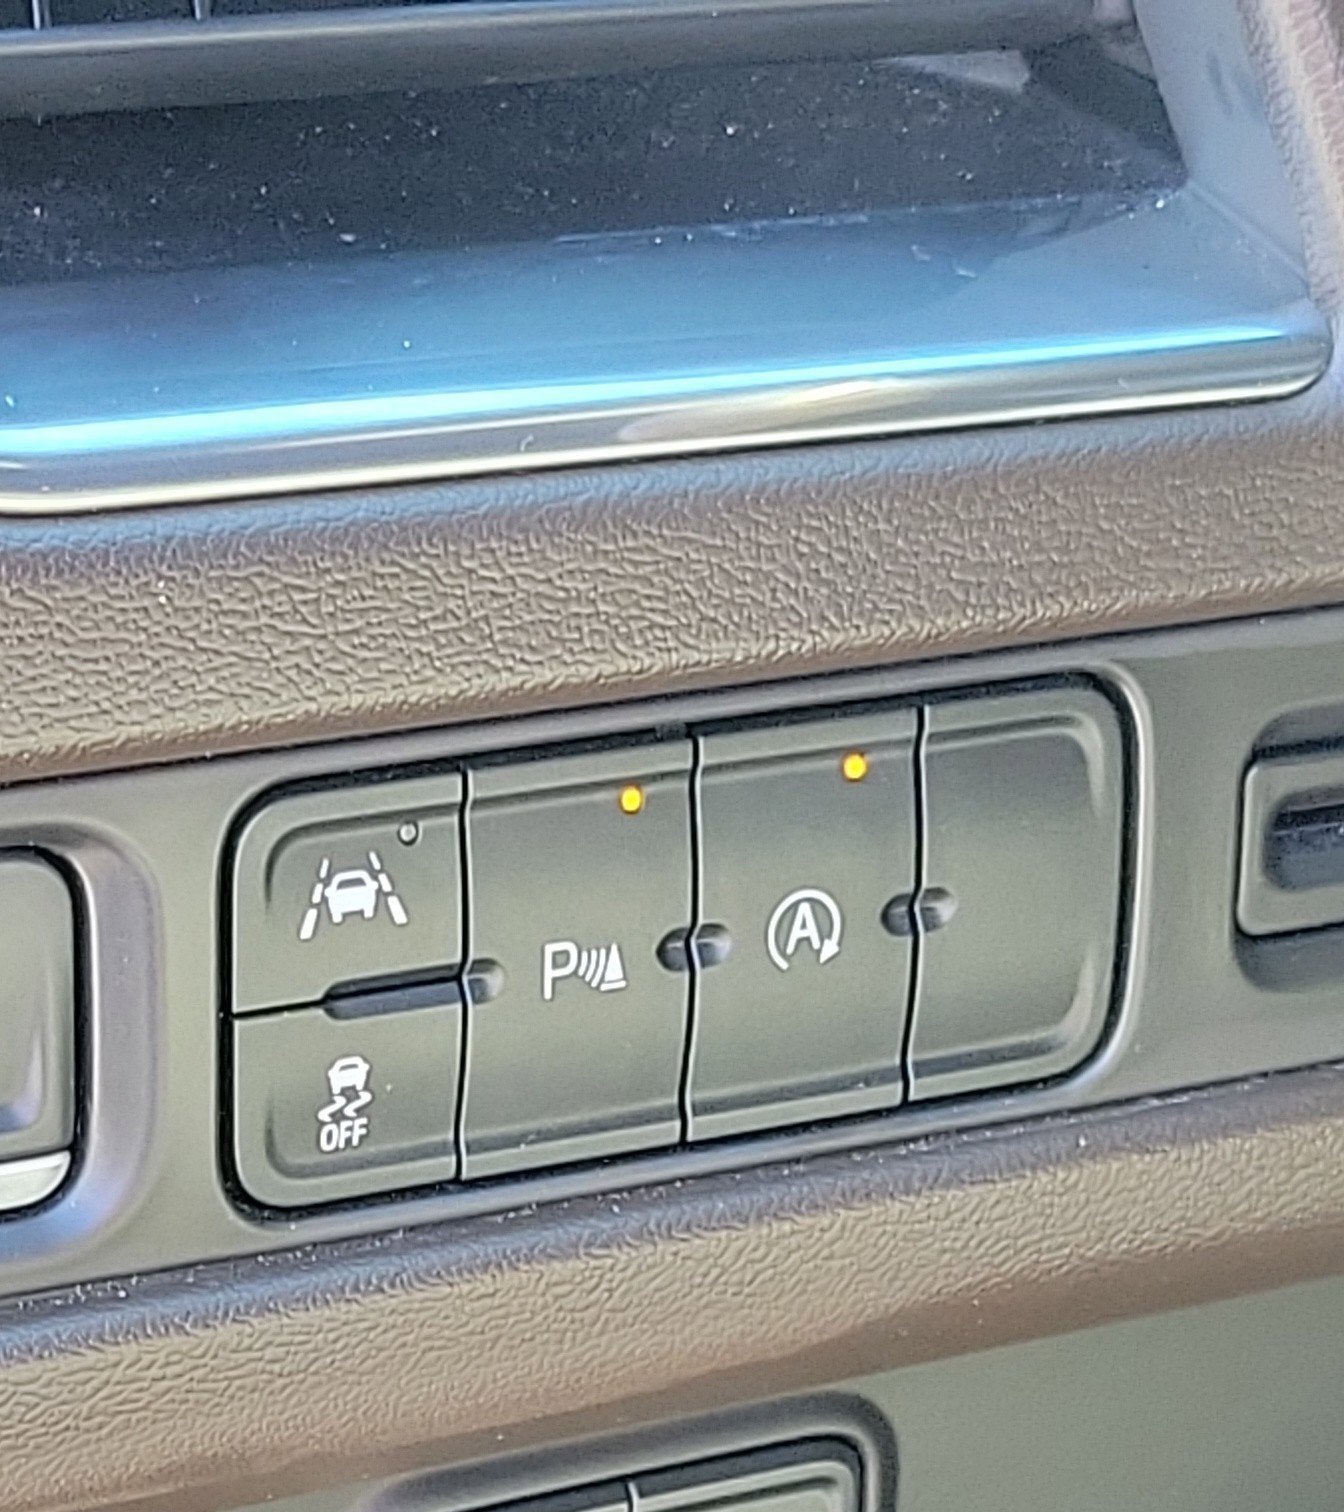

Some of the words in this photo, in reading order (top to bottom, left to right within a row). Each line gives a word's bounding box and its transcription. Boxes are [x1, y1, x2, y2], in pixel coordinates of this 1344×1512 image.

[785, 902, 821, 953] A
[542, 941, 577, 1000] P
[318, 1118, 368, 1151] OFF
